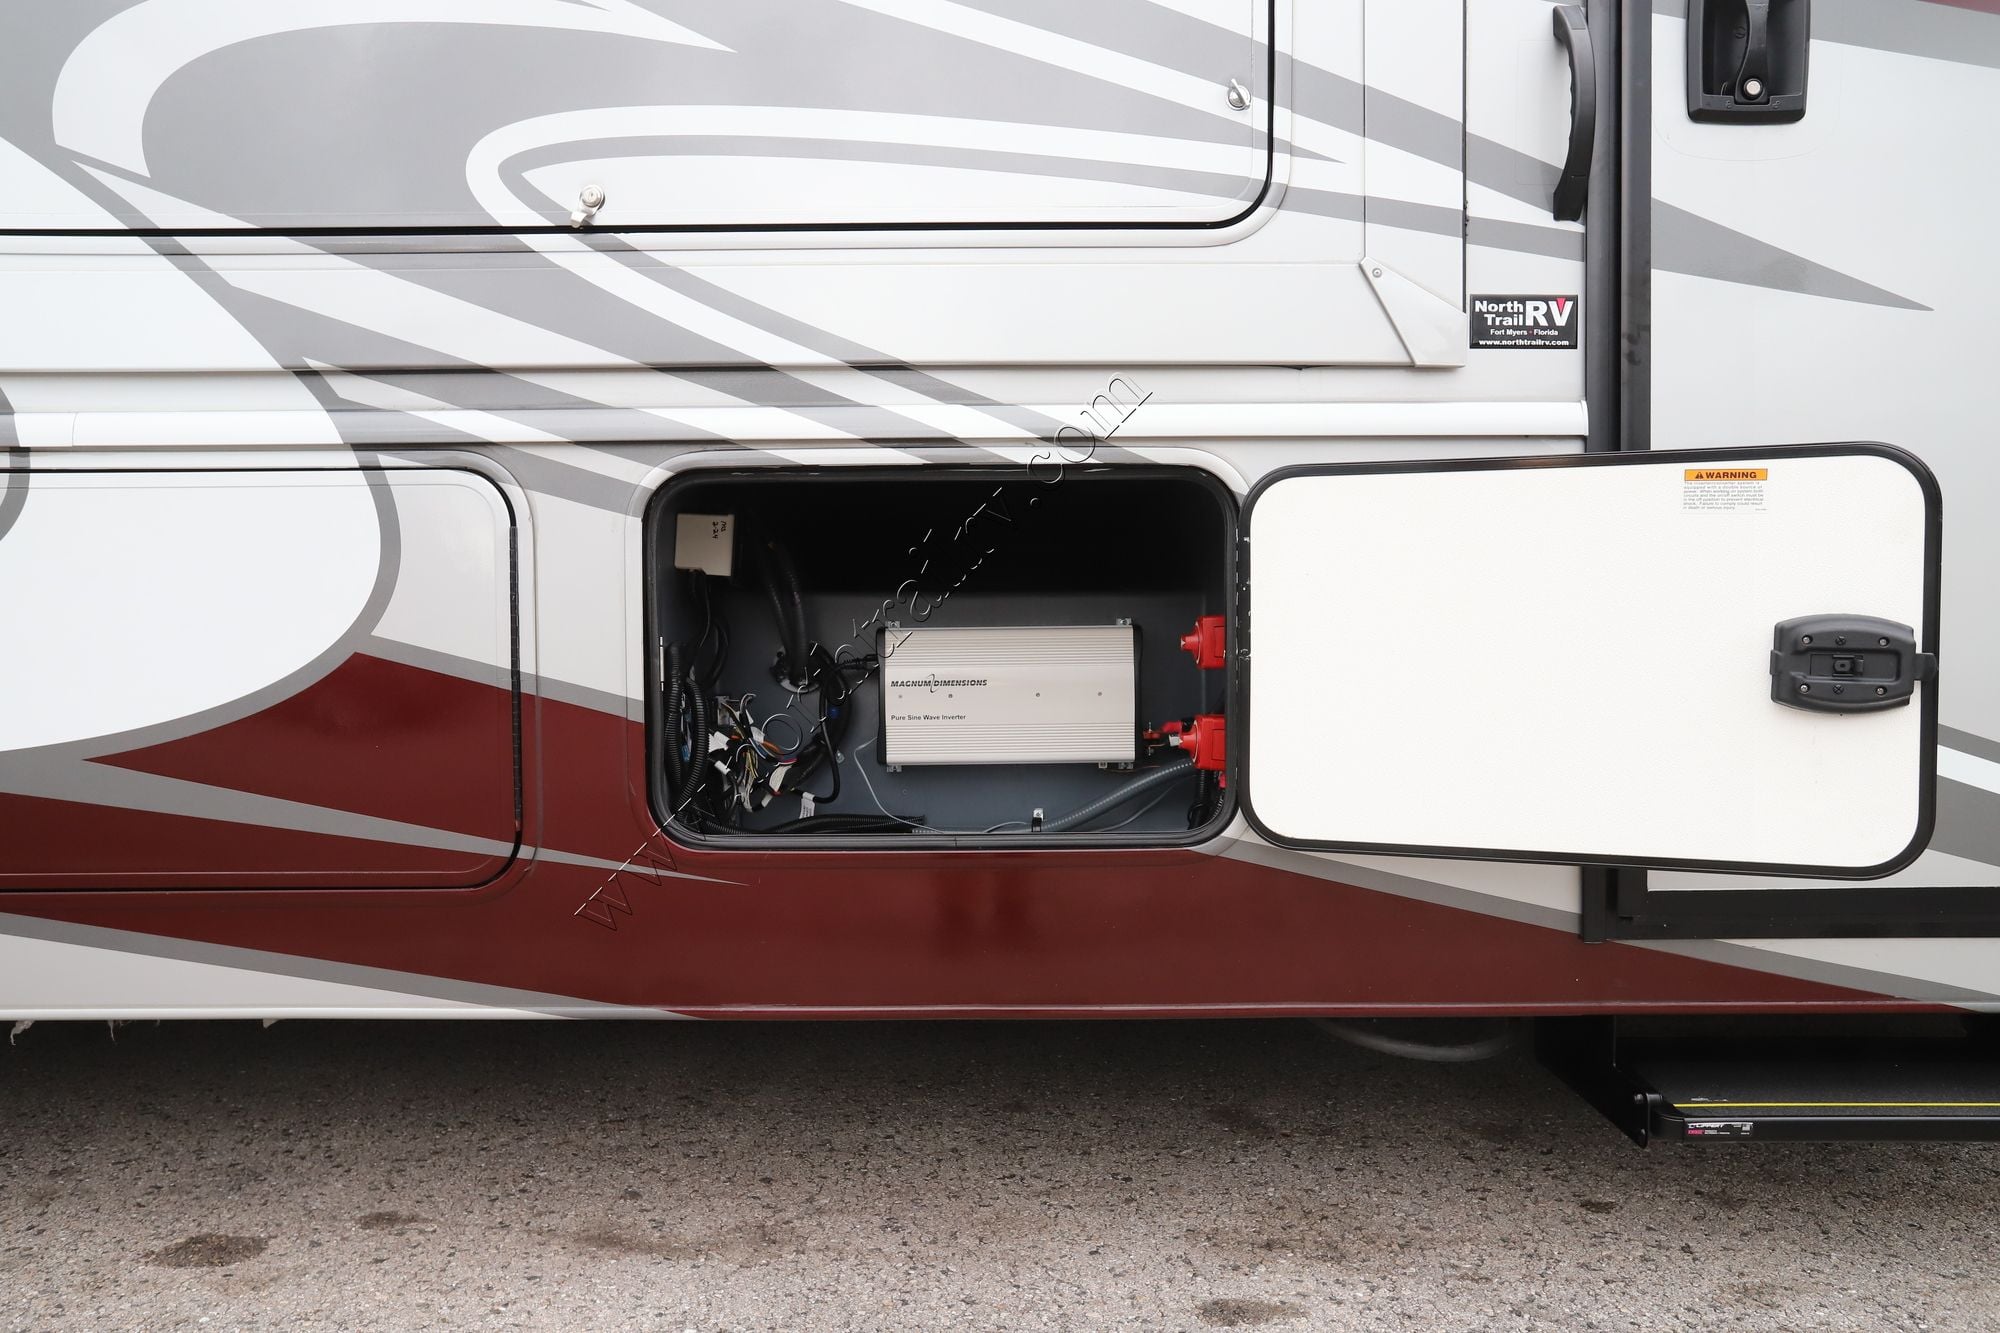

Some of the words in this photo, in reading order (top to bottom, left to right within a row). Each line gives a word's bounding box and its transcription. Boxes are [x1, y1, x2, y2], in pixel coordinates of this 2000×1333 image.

[1475, 300, 1523, 312] North
[1526, 300, 1574, 326] RV
[1484, 314, 1523, 326] Trail
[1705, 471, 1757, 479] WARNING
[933, 679, 987, 687] DIMENSIONS
